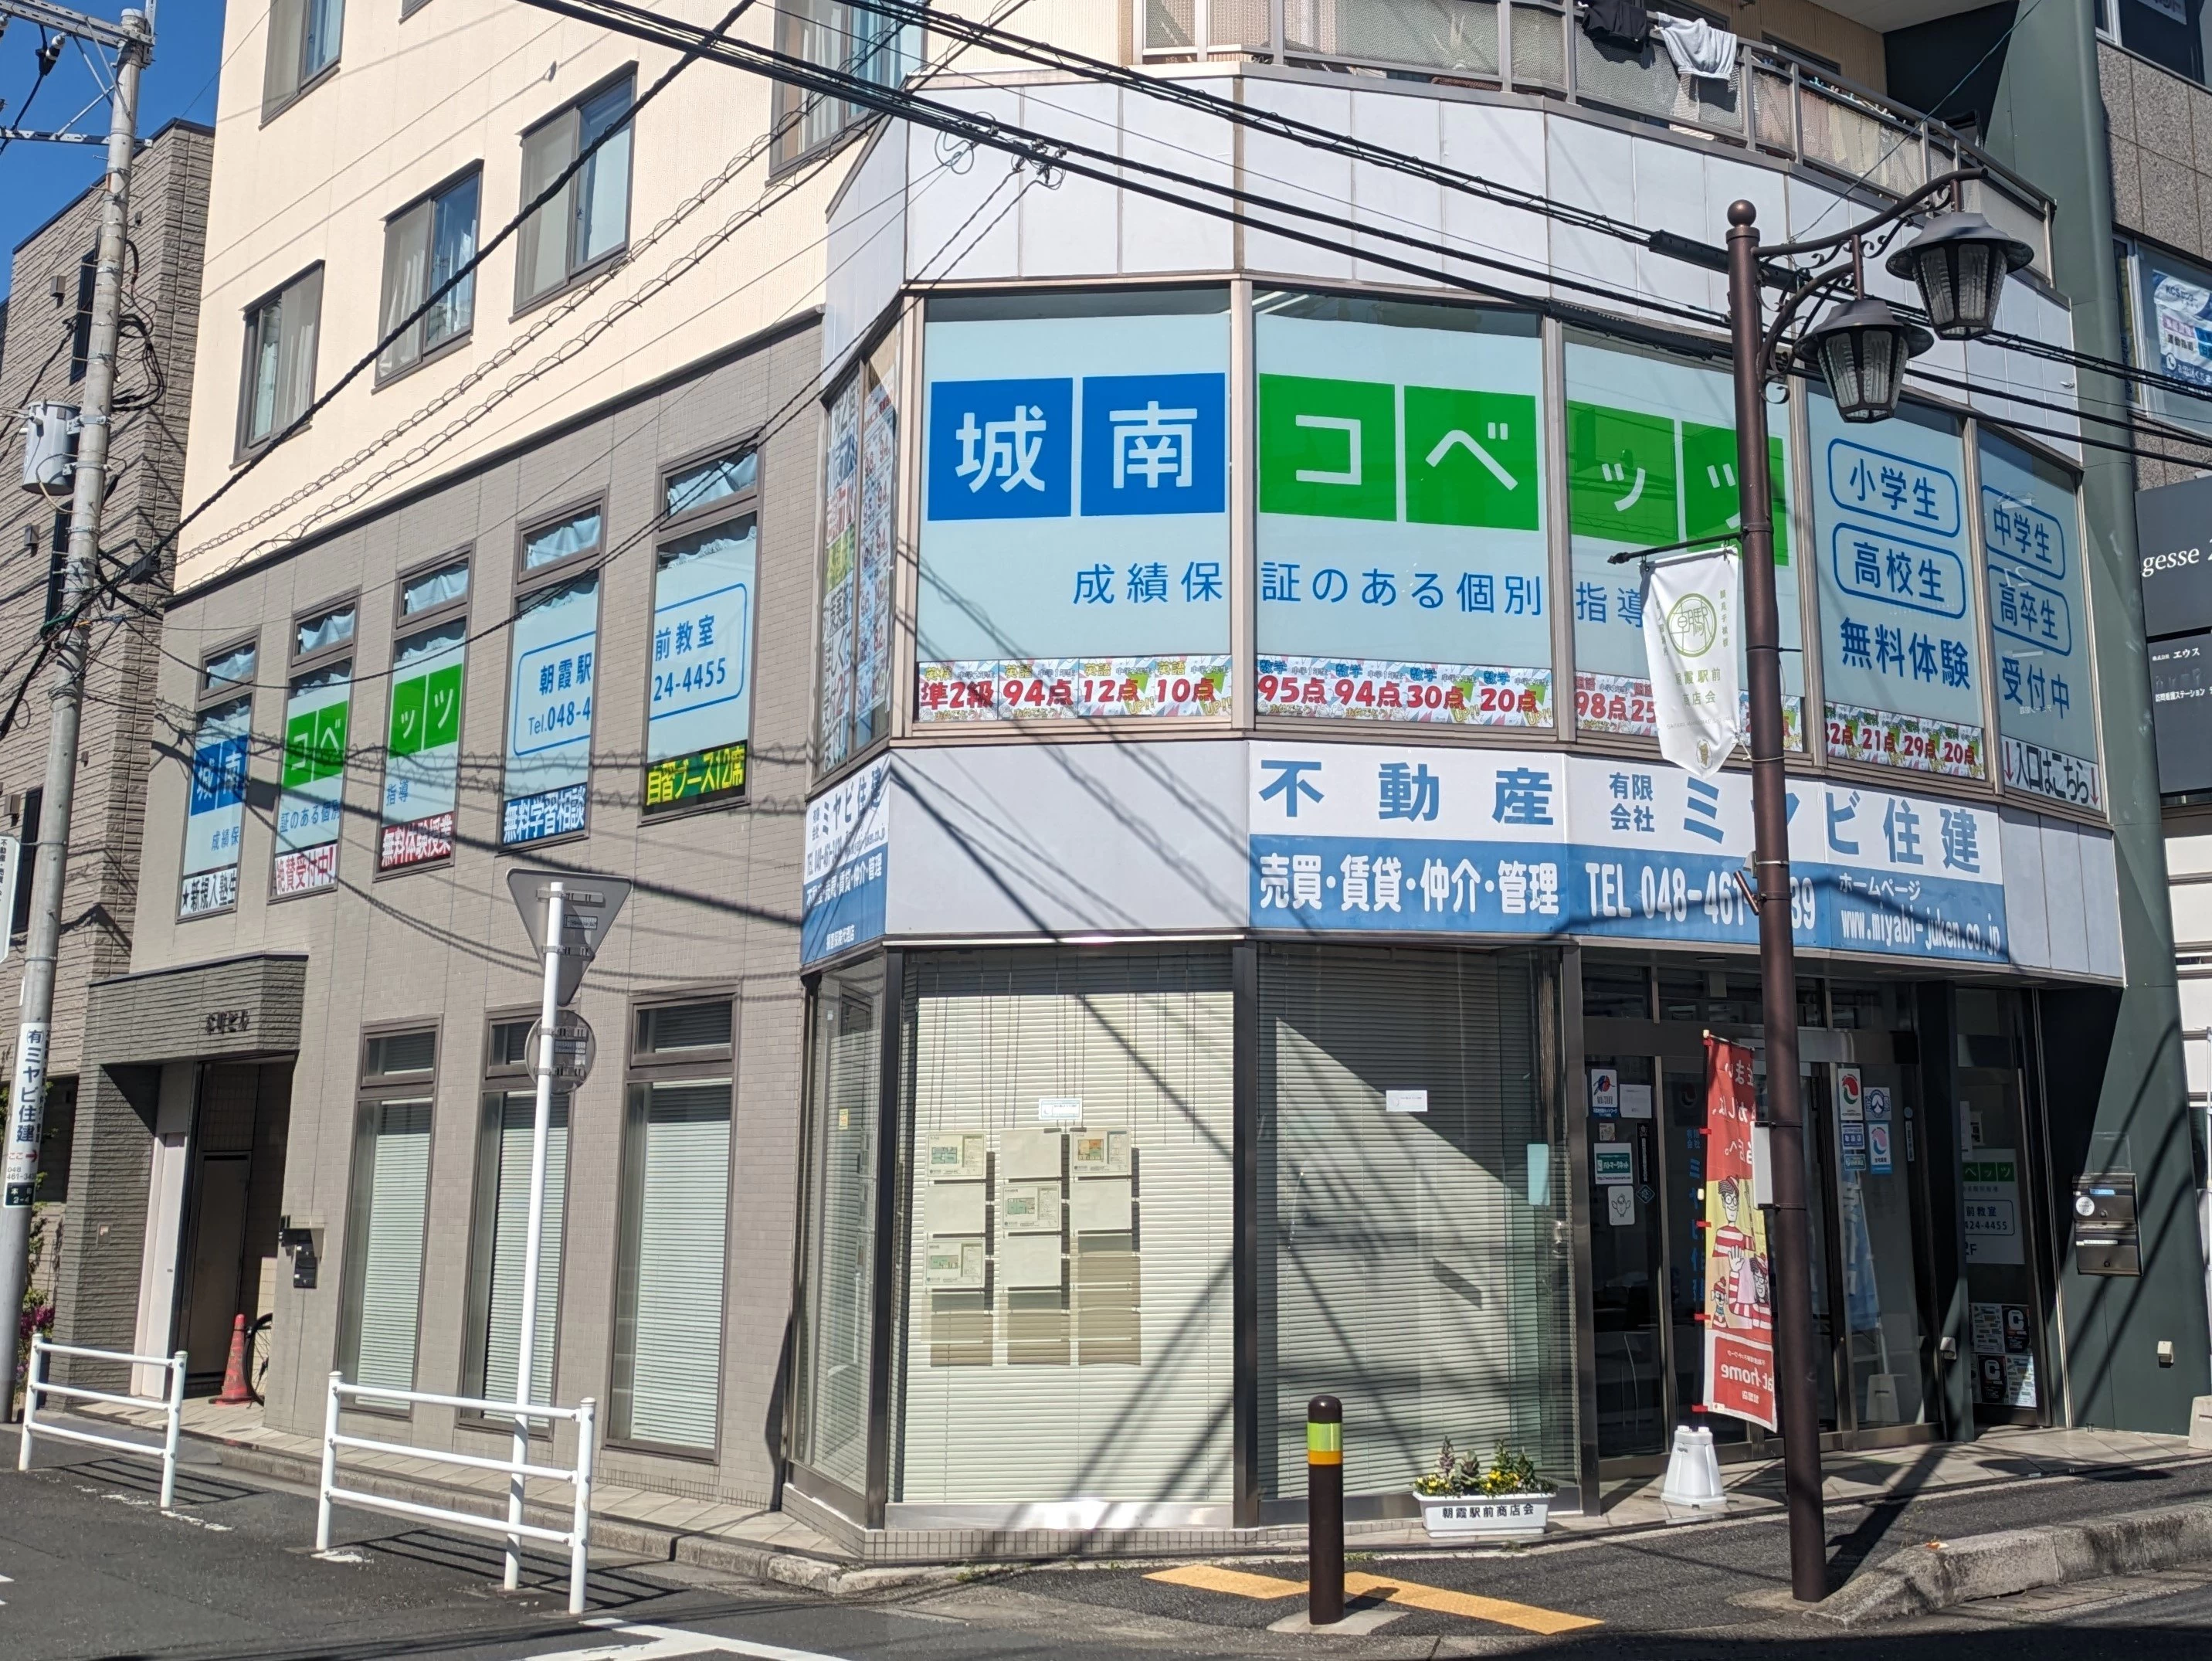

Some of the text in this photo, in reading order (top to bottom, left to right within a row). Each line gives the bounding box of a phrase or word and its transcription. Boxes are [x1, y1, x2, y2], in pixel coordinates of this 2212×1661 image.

[955, 401, 1197, 493] 城南
[1296, 415, 1518, 491] コベ
[1850, 459, 1939, 521] 小学生
[1994, 508, 2053, 564] 中学生
[1854, 542, 1945, 603] 高校生
[2142, 548, 2200, 577] gesse
[1074, 562, 1223, 604] 成績保
[1260, 561, 1542, 616] 証のある個別
[2000, 585, 2059, 641] 高卒生
[655, 615, 714, 661] 前教室
[2173, 647, 2200, 658] エウス
[1159, 661, 1186, 675] 英語
[1259, 659, 1288, 674] 数学
[1840, 617, 1970, 690] 無料体験
[539, 652, 592, 695] 朝霞駅
[653, 657, 726, 701] 24-4455
[1084, 662, 1111, 677] 英語
[1335, 663, 1363, 678] 数学
[1410, 667, 1437, 682] 数学
[1483, 671, 1511, 685] 数学
[1674, 667, 1721, 686] 朝霞駅前
[921, 681, 994, 710] 準2級
[1003, 679, 1074, 707] 94点
[1084, 678, 1140, 702] 12点
[1157, 678, 1216, 702] 10点
[1257, 675, 1328, 705] 95点
[1335, 679, 1403, 708] 94点
[1406, 684, 1466, 710] 30点
[1480, 688, 1539, 713] 20点
[1681, 690, 1715, 706] 商店会
[2002, 657, 2070, 719] 受付中
[1574, 691, 1629, 721] 98点
[291, 689, 453, 770] コベ ッツ
[1862, 728, 1897, 754] 21点
[1903, 735, 1937, 760] 29点
[1943, 742, 1978, 766] 20点
[196, 751, 244, 800] 城南
[646, 745, 745, 807] 自習ブース12席
[1609, 772, 1653, 802] 有限
[2017, 742, 2089, 803] 入口はこちら
[1259, 759, 1554, 826] 不動産
[504, 785, 585, 843] 無料学習相談
[1610, 803, 1655, 833] 会社
[382, 814, 453, 867] 無料体験授業
[1260, 852, 1559, 915] 売買・賃貸・仲介・管理
[1585, 862, 1631, 918] TEL
[1839, 873, 1921, 902] ホームページ
[1841, 905, 2000, 956] www.miyabi-juken.co.jp
[8, 1152, 22, 1160] ここ
[1966, 1206, 1997, 1217] 前教室
[1441, 1502, 1534, 1519] 朝霞駅前商店会
